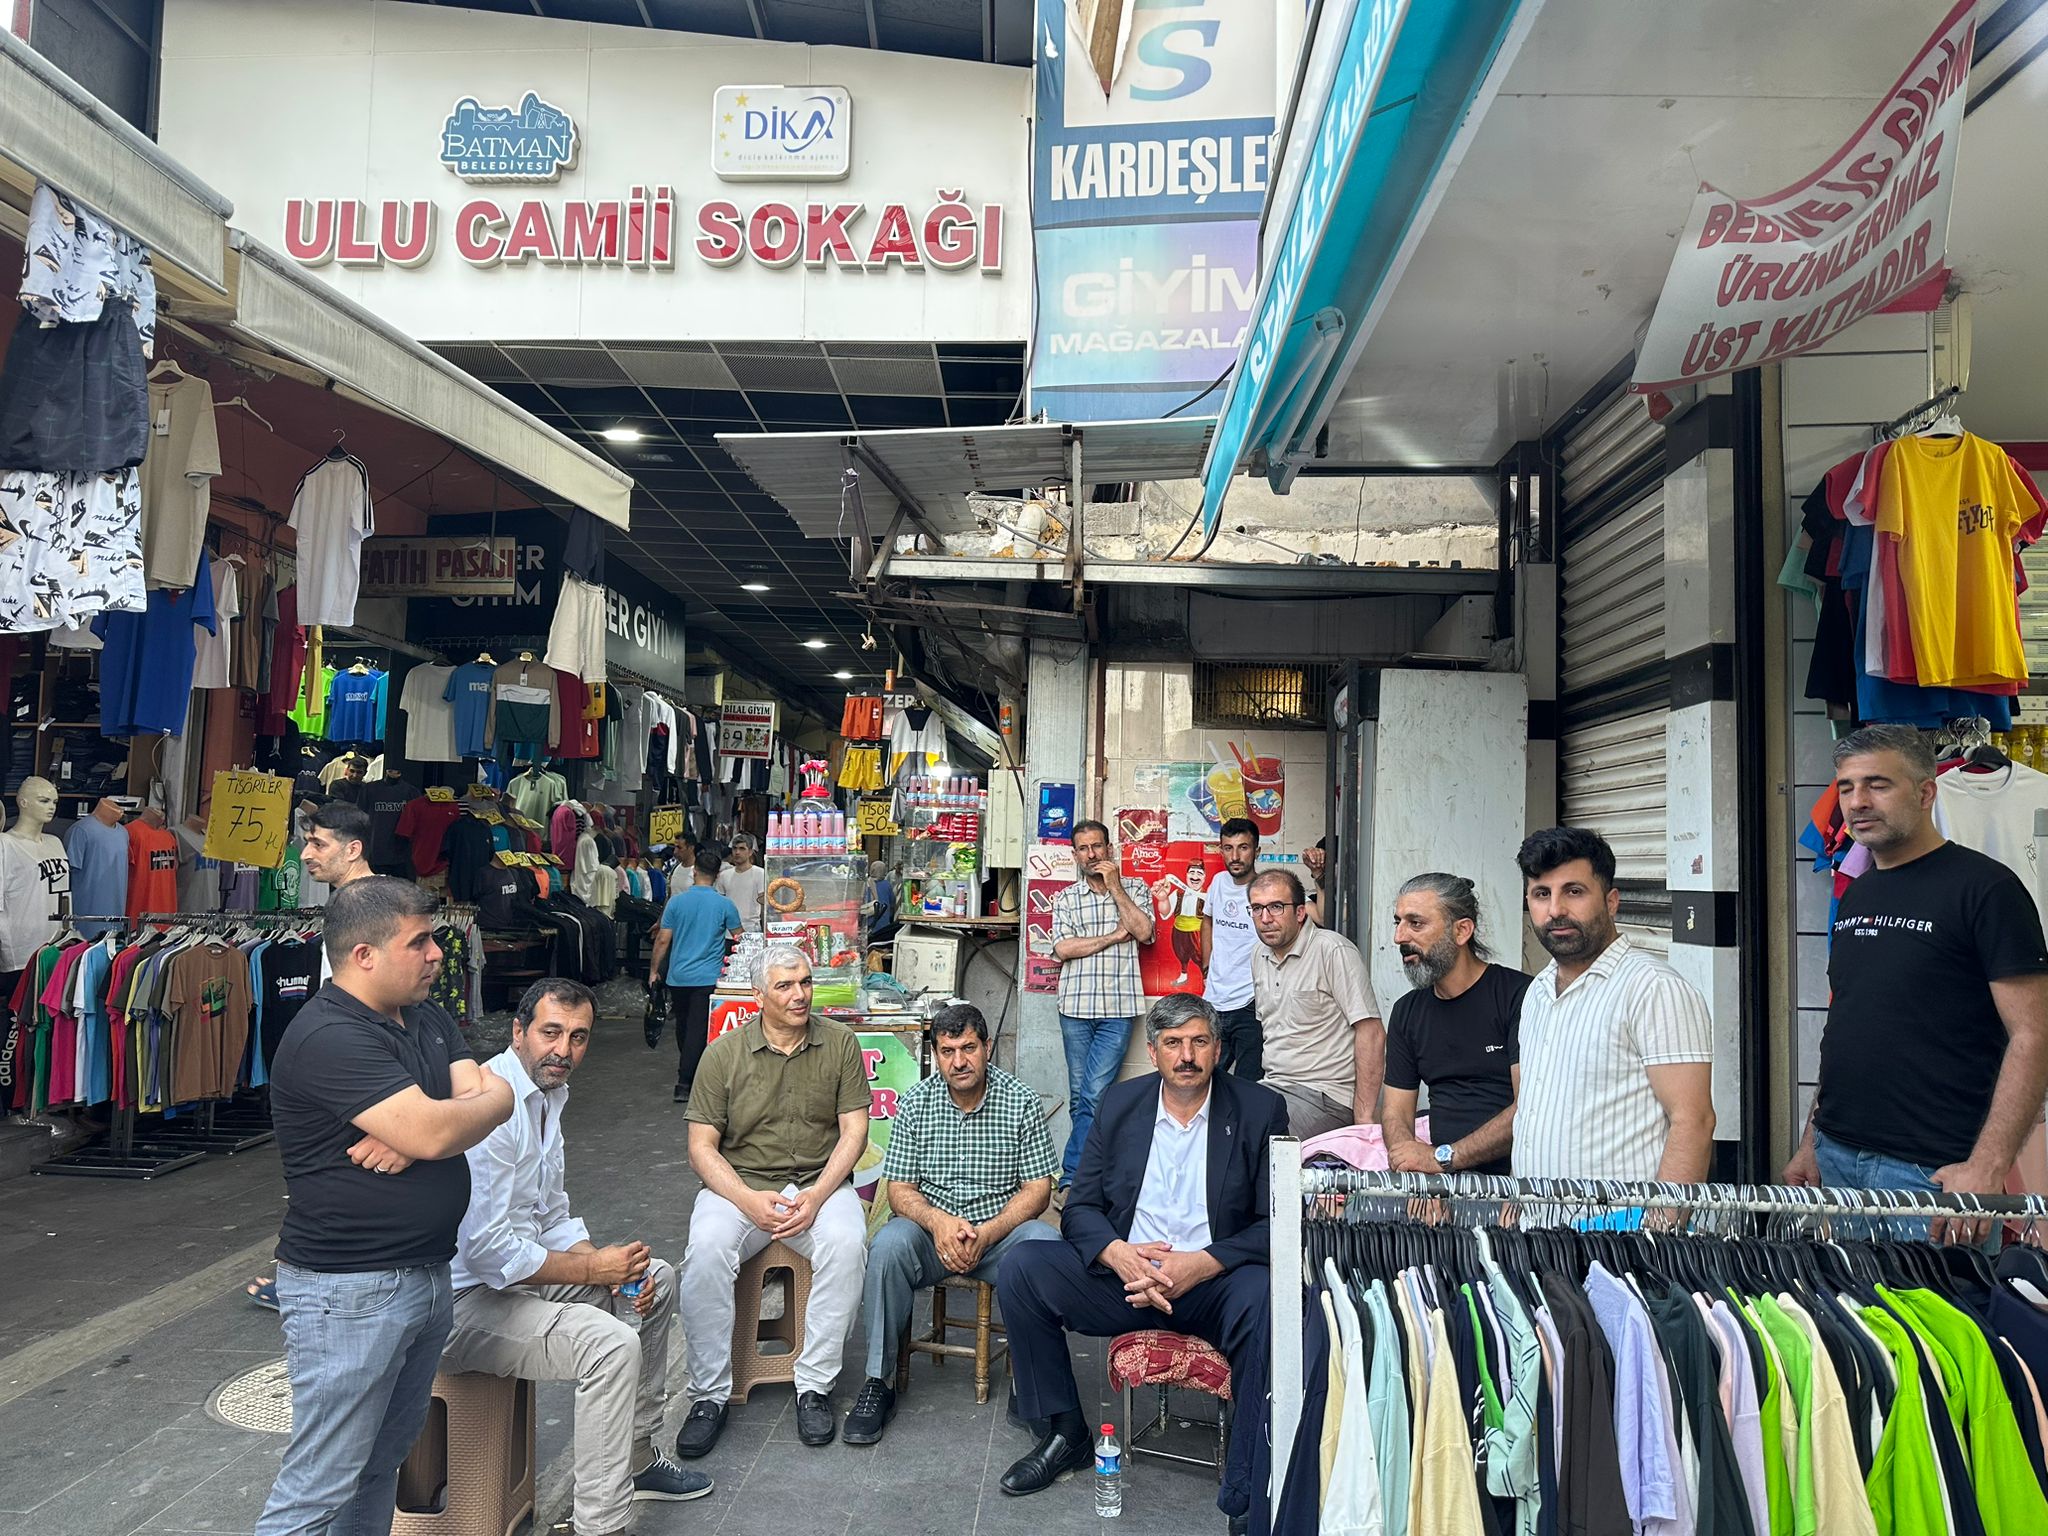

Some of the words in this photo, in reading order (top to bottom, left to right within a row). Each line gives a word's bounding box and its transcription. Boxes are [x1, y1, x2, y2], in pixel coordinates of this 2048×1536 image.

[744, 105, 833, 140] DİKA
[445, 134, 568, 158] BATMAN
[461, 160, 549, 170] BELEDİYESİ
[284, 198, 434, 264] ULU
[454, 184, 673, 266] CAMİİ
[693, 186, 1004, 270] SOKAĞI
[1715, 131, 1945, 308] ÜRÜNLERİMİZ
[1062, 254, 1258, 318] GİYİM
[1680, 320, 1763, 377] ÜST
[1757, 219, 1932, 361] KATTADIR
[633, 600, 678, 665] GİYİM
[430, 790, 448, 800] 50
[228, 805, 266, 843] 75
[656, 827, 674, 843] 50
[865, 817, 888, 832] 50
[1215, 918, 1249, 930] MONCLER
[1834, 915, 1863, 932] TOMMY
[1873, 915, 1933, 934] HILFIGER
